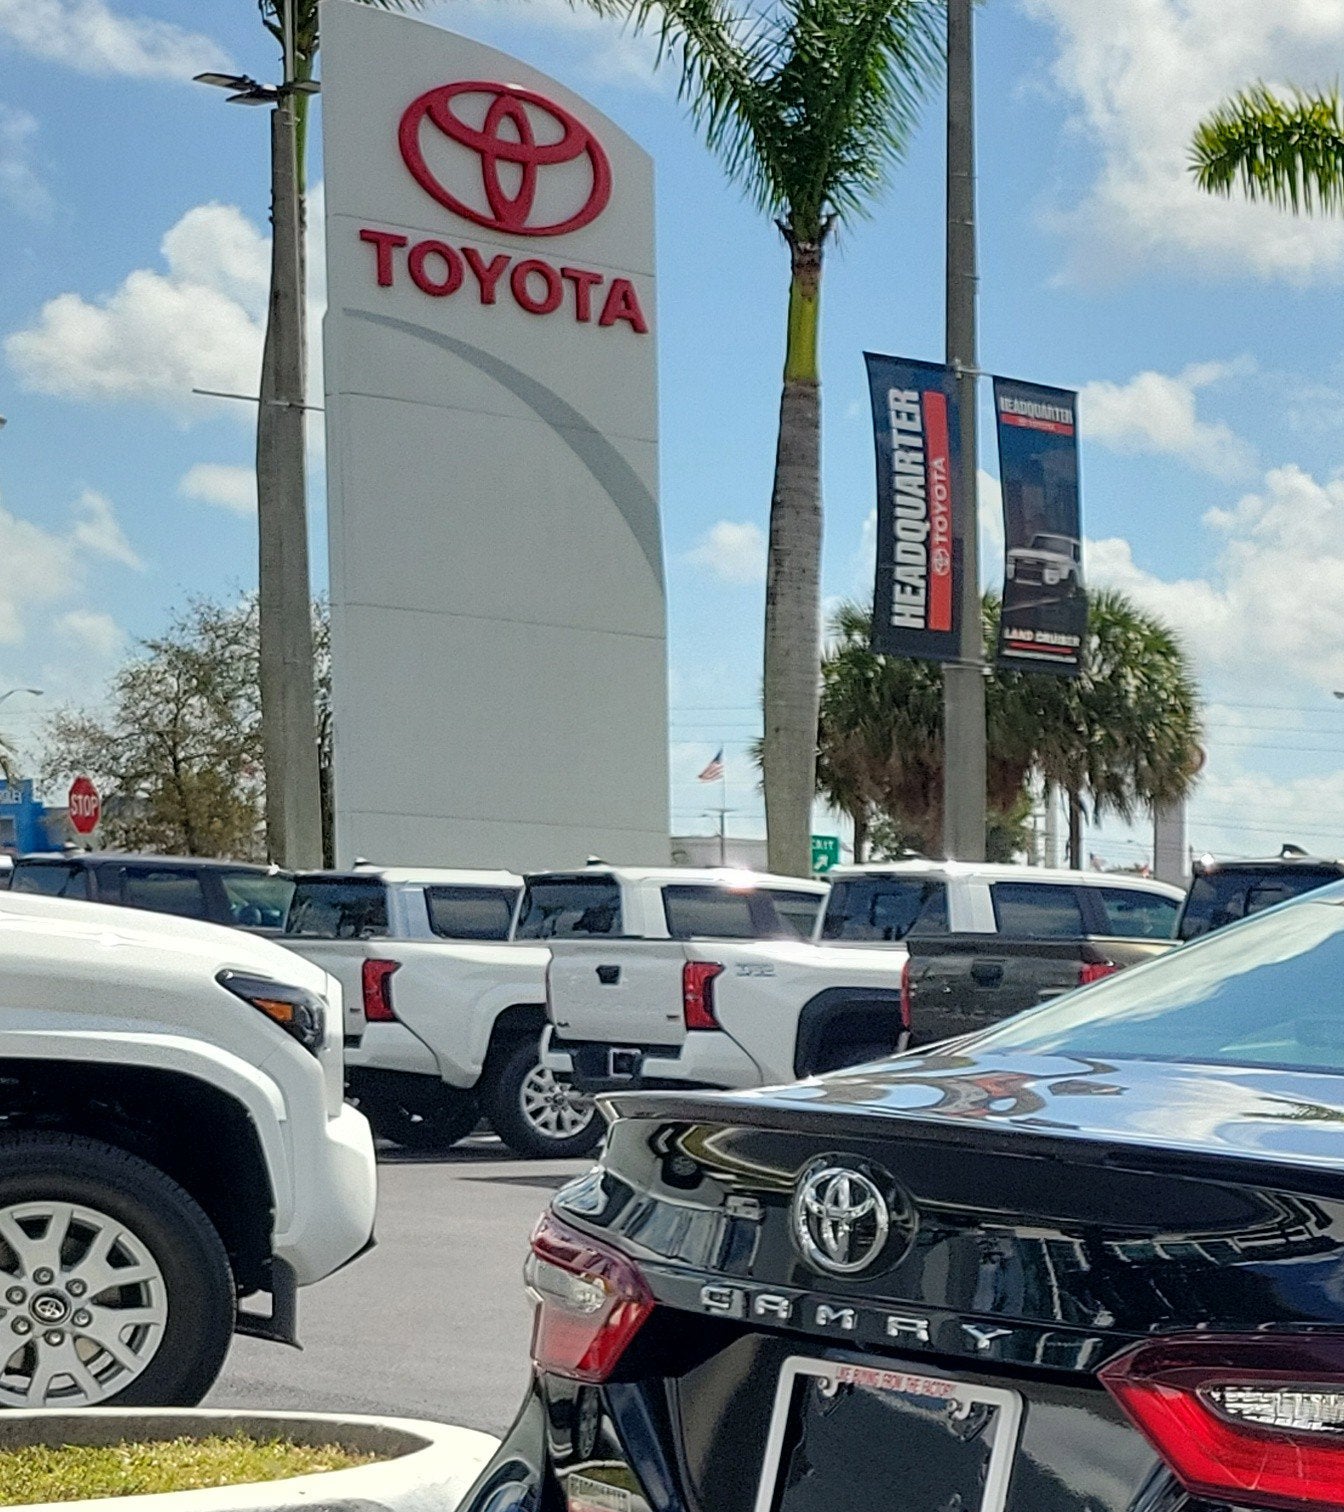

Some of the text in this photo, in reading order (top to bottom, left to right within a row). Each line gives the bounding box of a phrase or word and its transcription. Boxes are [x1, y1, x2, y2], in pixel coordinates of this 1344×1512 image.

[359, 229, 648, 334] TOYOTA
[889, 387, 930, 630] HEADQUARTER
[933, 457, 949, 545] TOYOTA
[1003, 626, 1034, 642] LAND
[71, 794, 98, 816] STOP
[700, 1285, 1014, 1349] CAMRY
